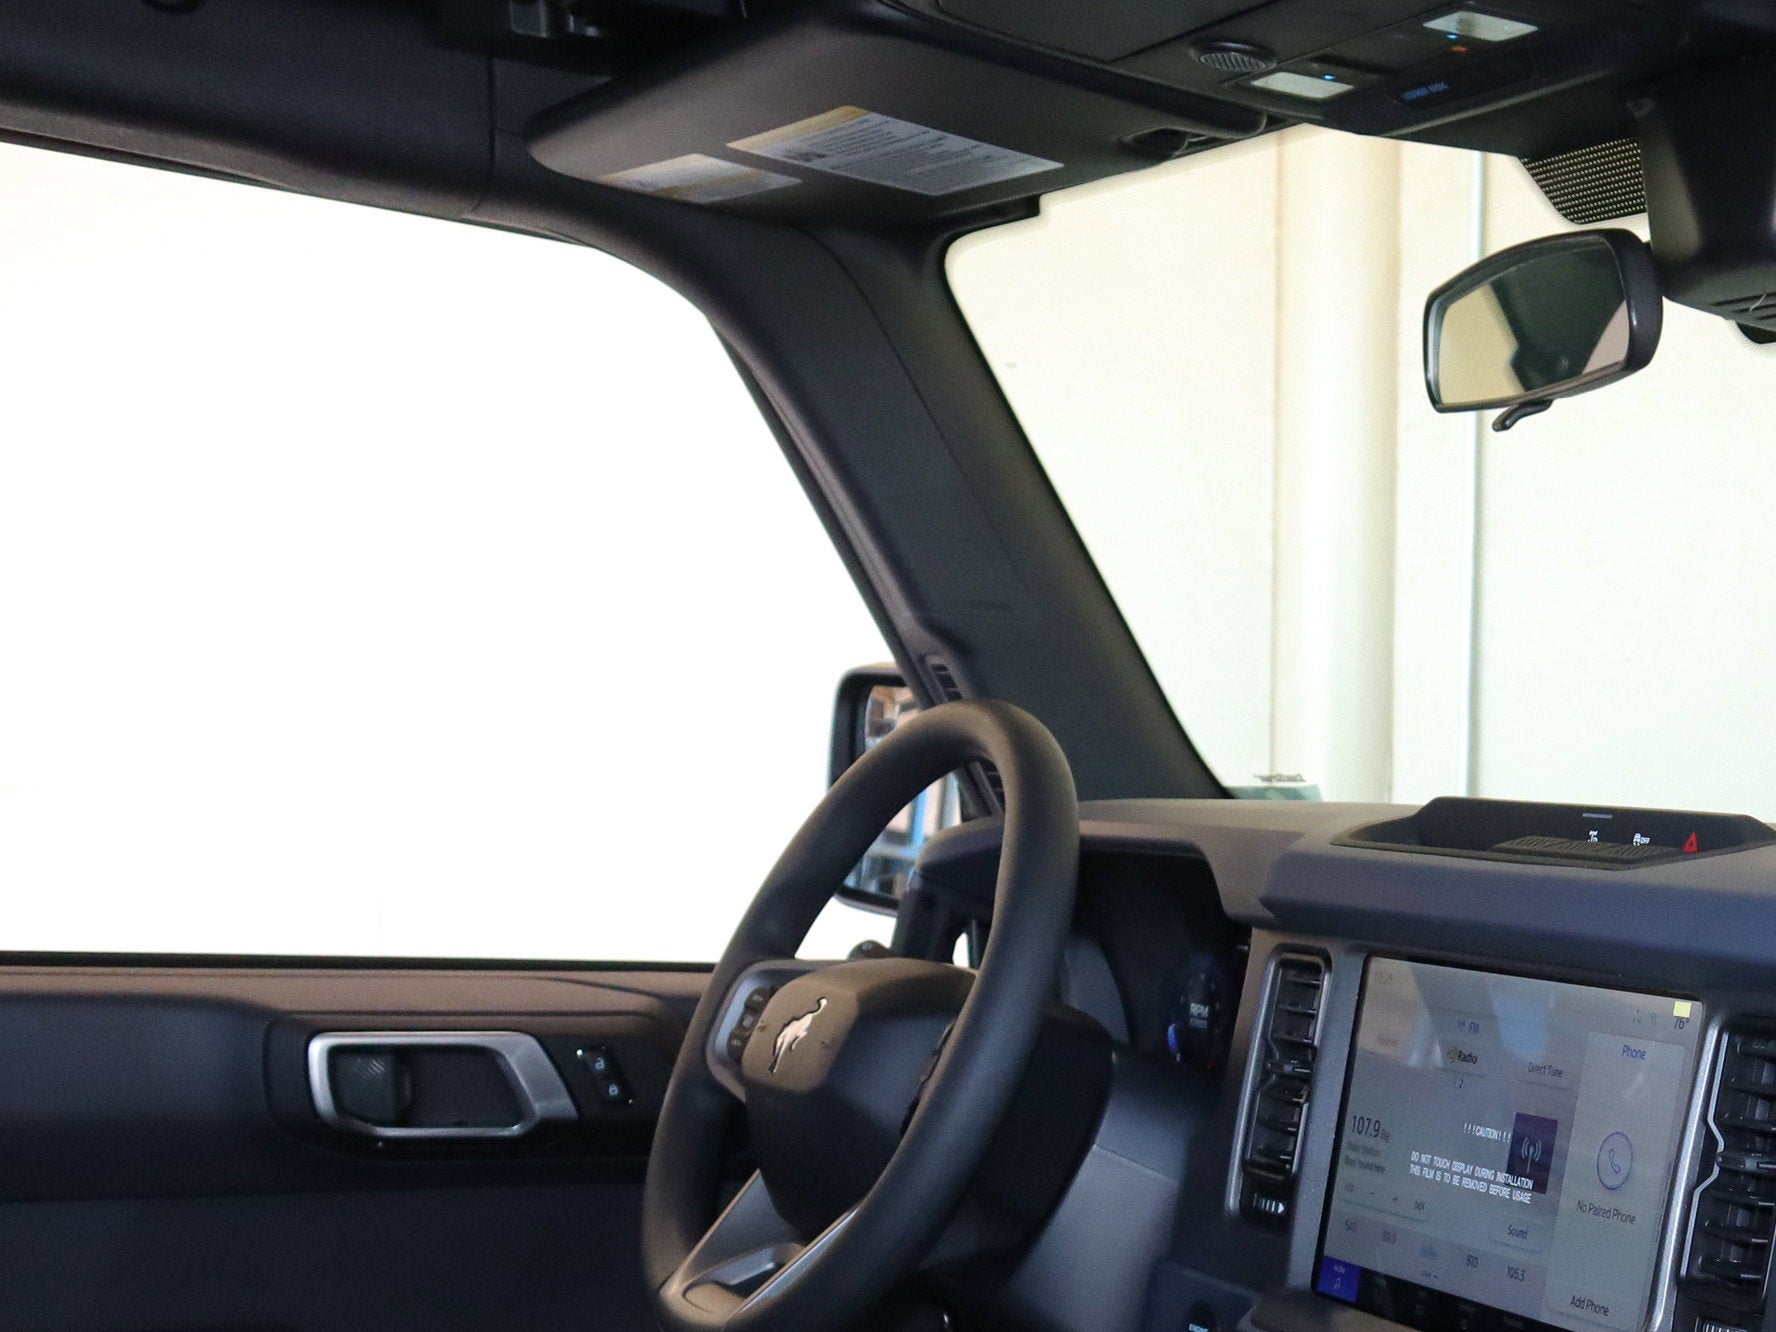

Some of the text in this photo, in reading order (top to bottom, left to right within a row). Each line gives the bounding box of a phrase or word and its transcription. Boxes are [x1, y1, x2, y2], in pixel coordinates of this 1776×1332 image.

[1457, 1050, 1478, 1065] Radio
[1621, 1044, 1647, 1060] Phone
[1351, 1115, 1381, 1138] 107.9
[1411, 1151, 1534, 1190] DO NOT TOUCH DISPLAY DURING INSTALLATION
[1409, 1164, 1532, 1204] THIS FILM IS TO BE REMOVED BEFORE USAGE
[1577, 1200, 1636, 1225] No Paired Phone
[1507, 1224, 1528, 1240] Sound
[1570, 1295, 1610, 1316] Add Phone
